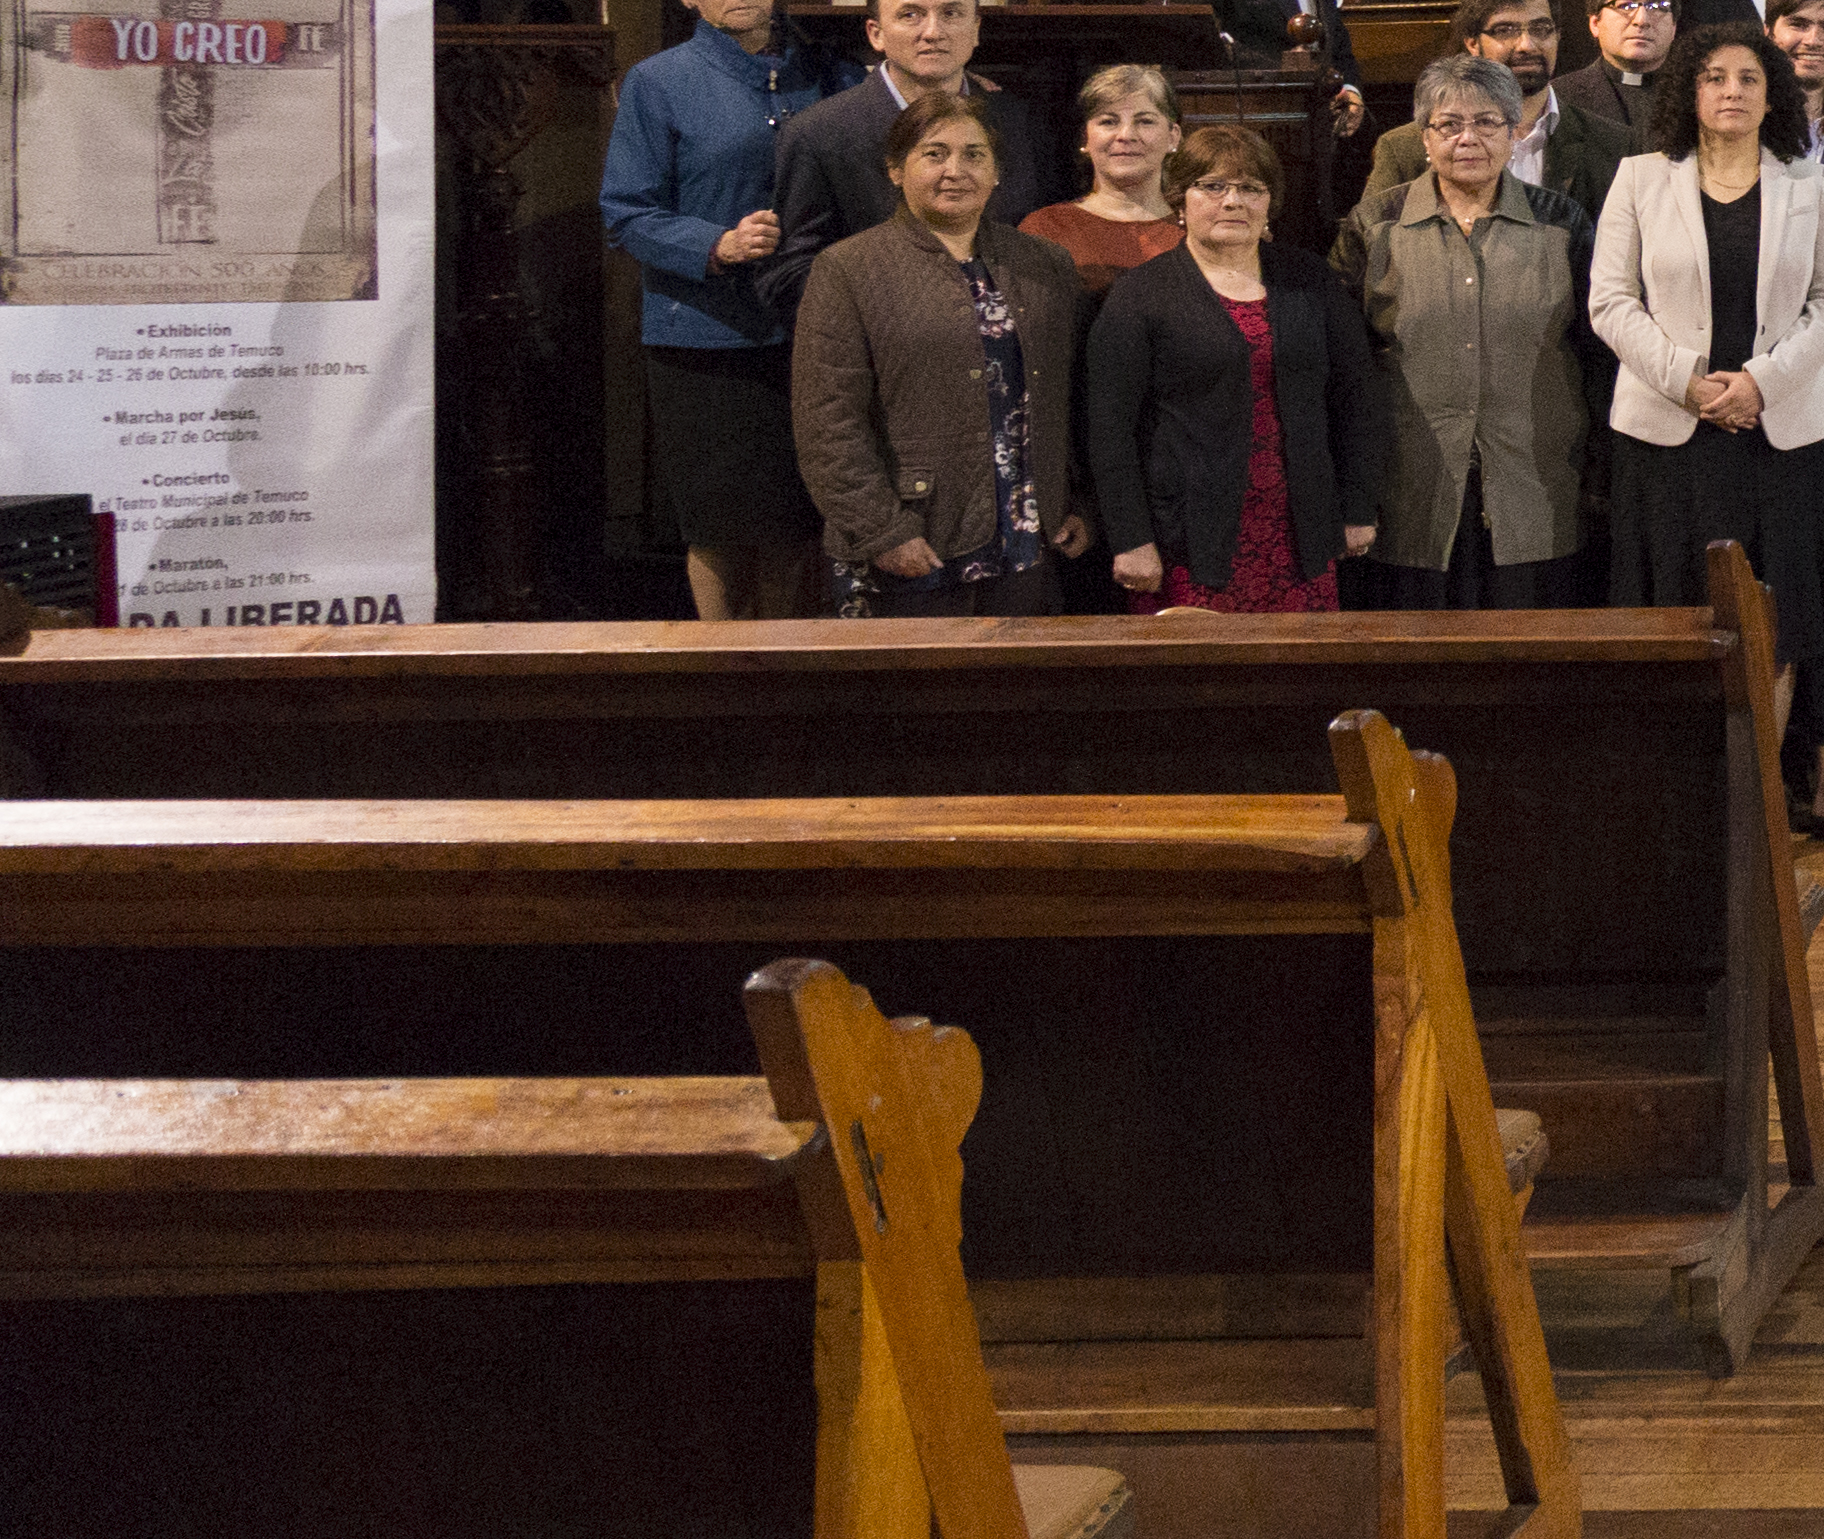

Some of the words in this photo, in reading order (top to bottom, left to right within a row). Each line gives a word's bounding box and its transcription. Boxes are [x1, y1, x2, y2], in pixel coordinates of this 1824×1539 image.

[111, 19, 158, 62] YO
[173, 21, 268, 65] CREO
[137, 347, 154, 360] de
[208, 346, 225, 358] de
[230, 344, 284, 358] Temuco
[115, 411, 173, 425] Marcha
[179, 411, 205, 426] por
[181, 430, 199, 443] de
[152, 471, 230, 487] Concierto
[253, 489, 310, 504] Temuco
